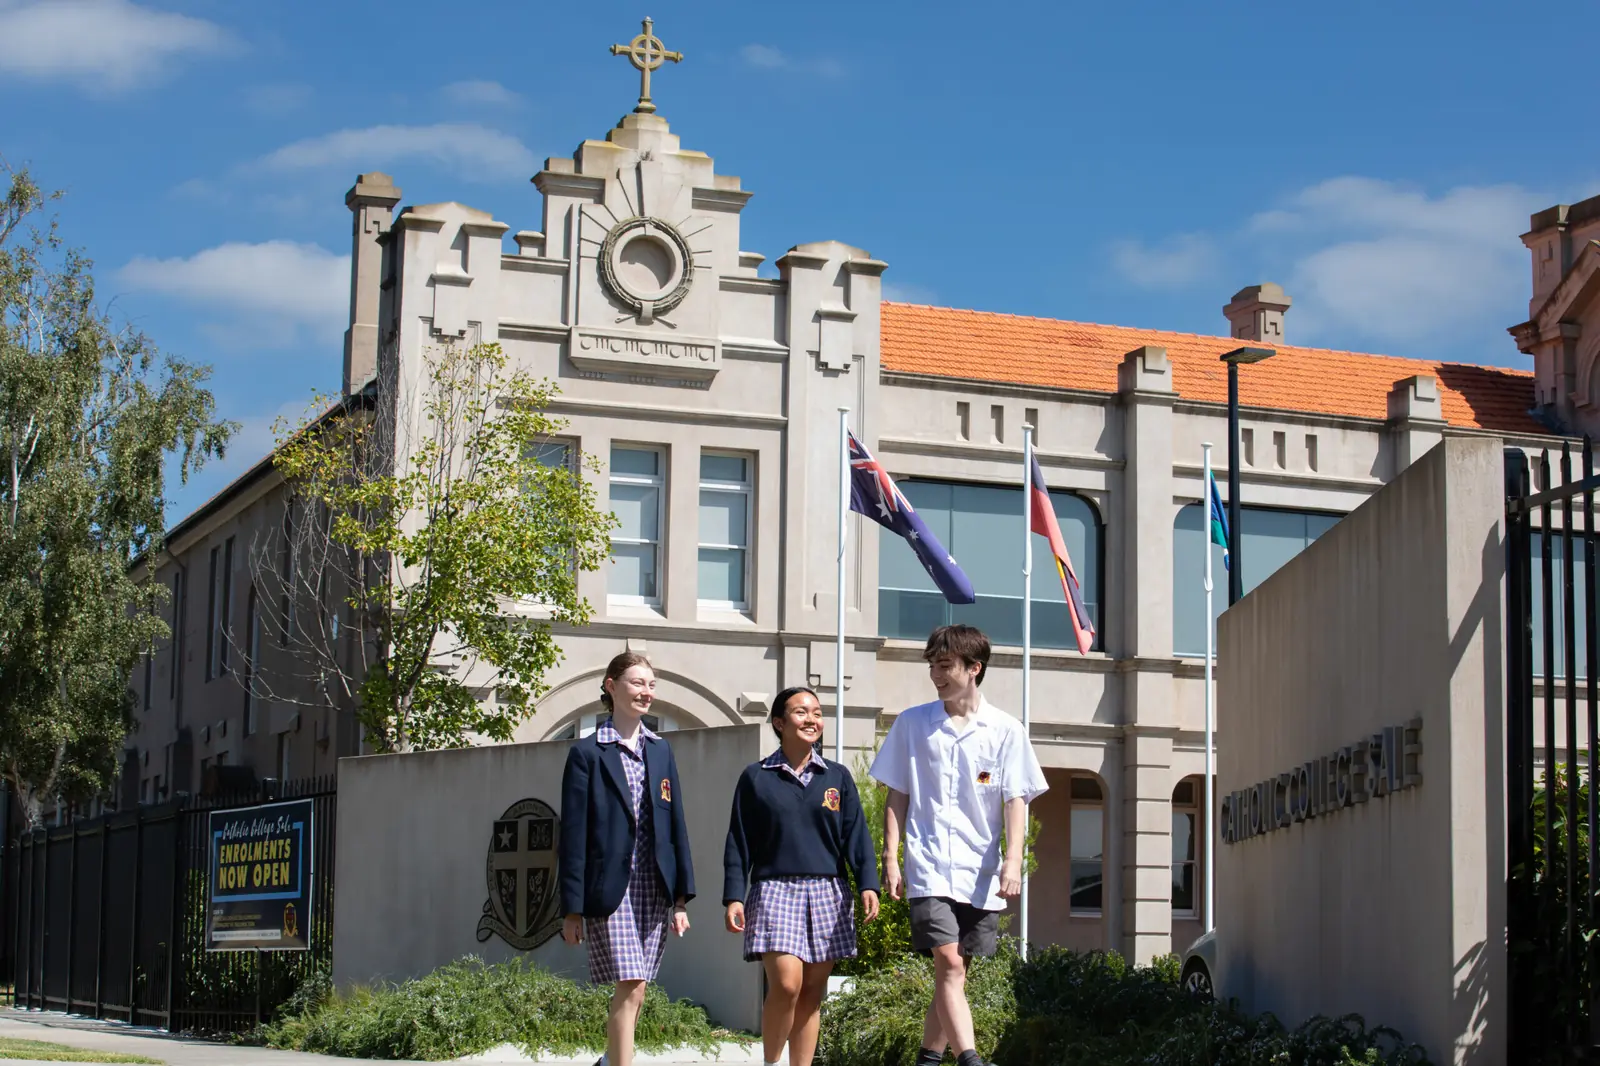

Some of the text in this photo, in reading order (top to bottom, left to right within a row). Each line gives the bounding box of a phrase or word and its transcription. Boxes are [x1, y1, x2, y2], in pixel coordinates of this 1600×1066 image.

[1220, 716, 1424, 844] CATHOLIC COLLEGE SALE
[222, 813, 291, 842] Catholic College Sale
[220, 838, 291, 864] ENROLMENTS
[219, 861, 290, 889] NOW OPEN
